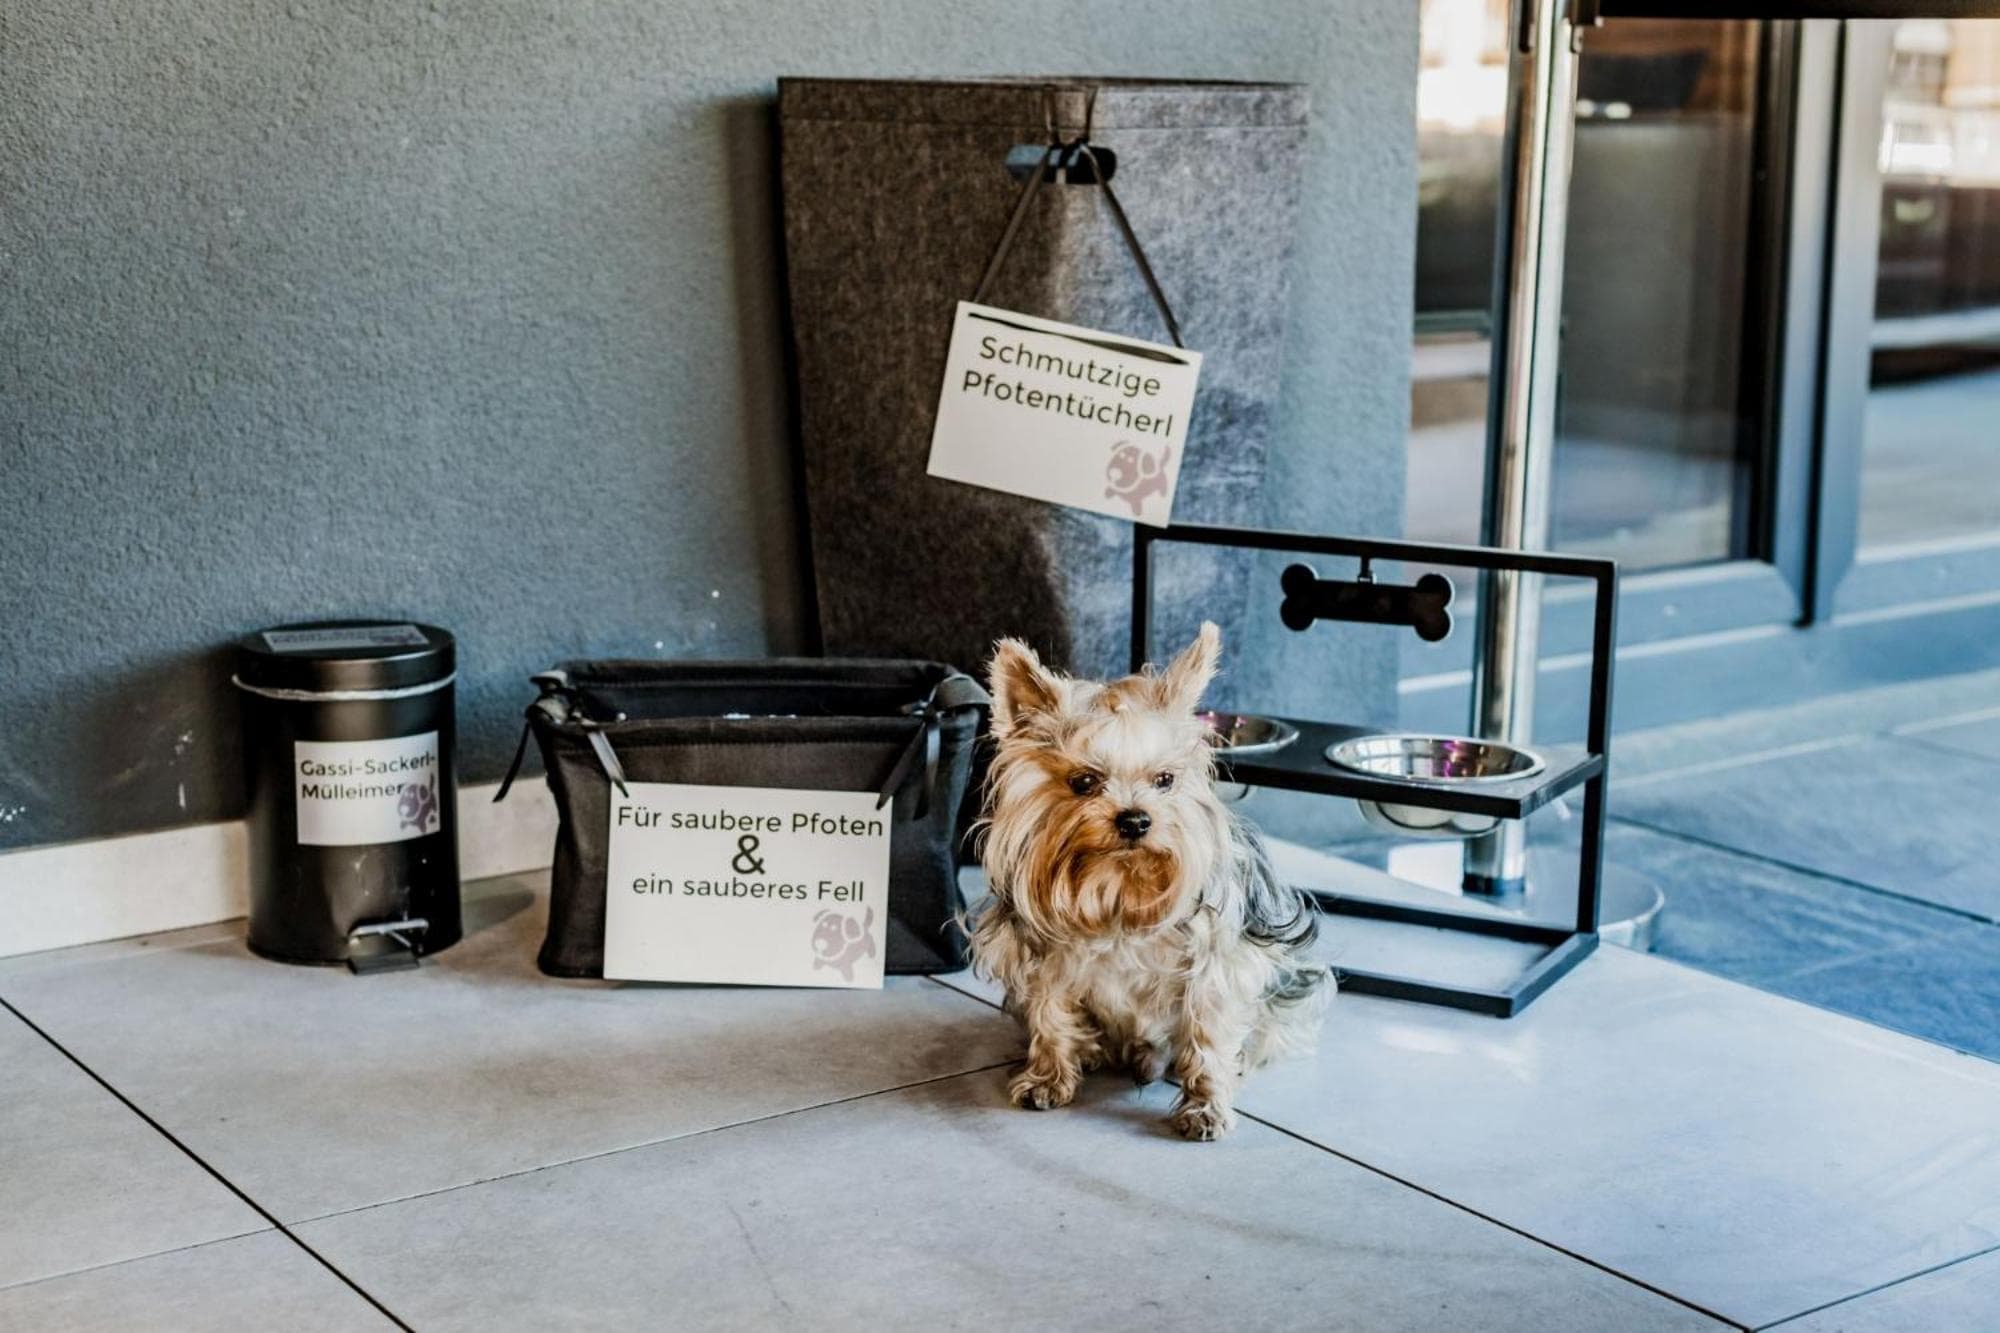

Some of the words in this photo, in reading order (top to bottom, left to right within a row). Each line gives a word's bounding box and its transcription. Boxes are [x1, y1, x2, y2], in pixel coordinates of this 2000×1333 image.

[980, 336, 1161, 397] Schmutzige
[962, 370, 1174, 437] Pfotentücherl
[302, 782, 405, 800] Mülleimer
[617, 806, 662, 827] Für
[671, 809, 782, 832] saubere
[792, 813, 883, 836] Pfoten
[731, 834, 766, 875] &
[632, 873, 673, 895] ein
[683, 877, 807, 900] sauberes
[818, 881, 864, 902] Fell
